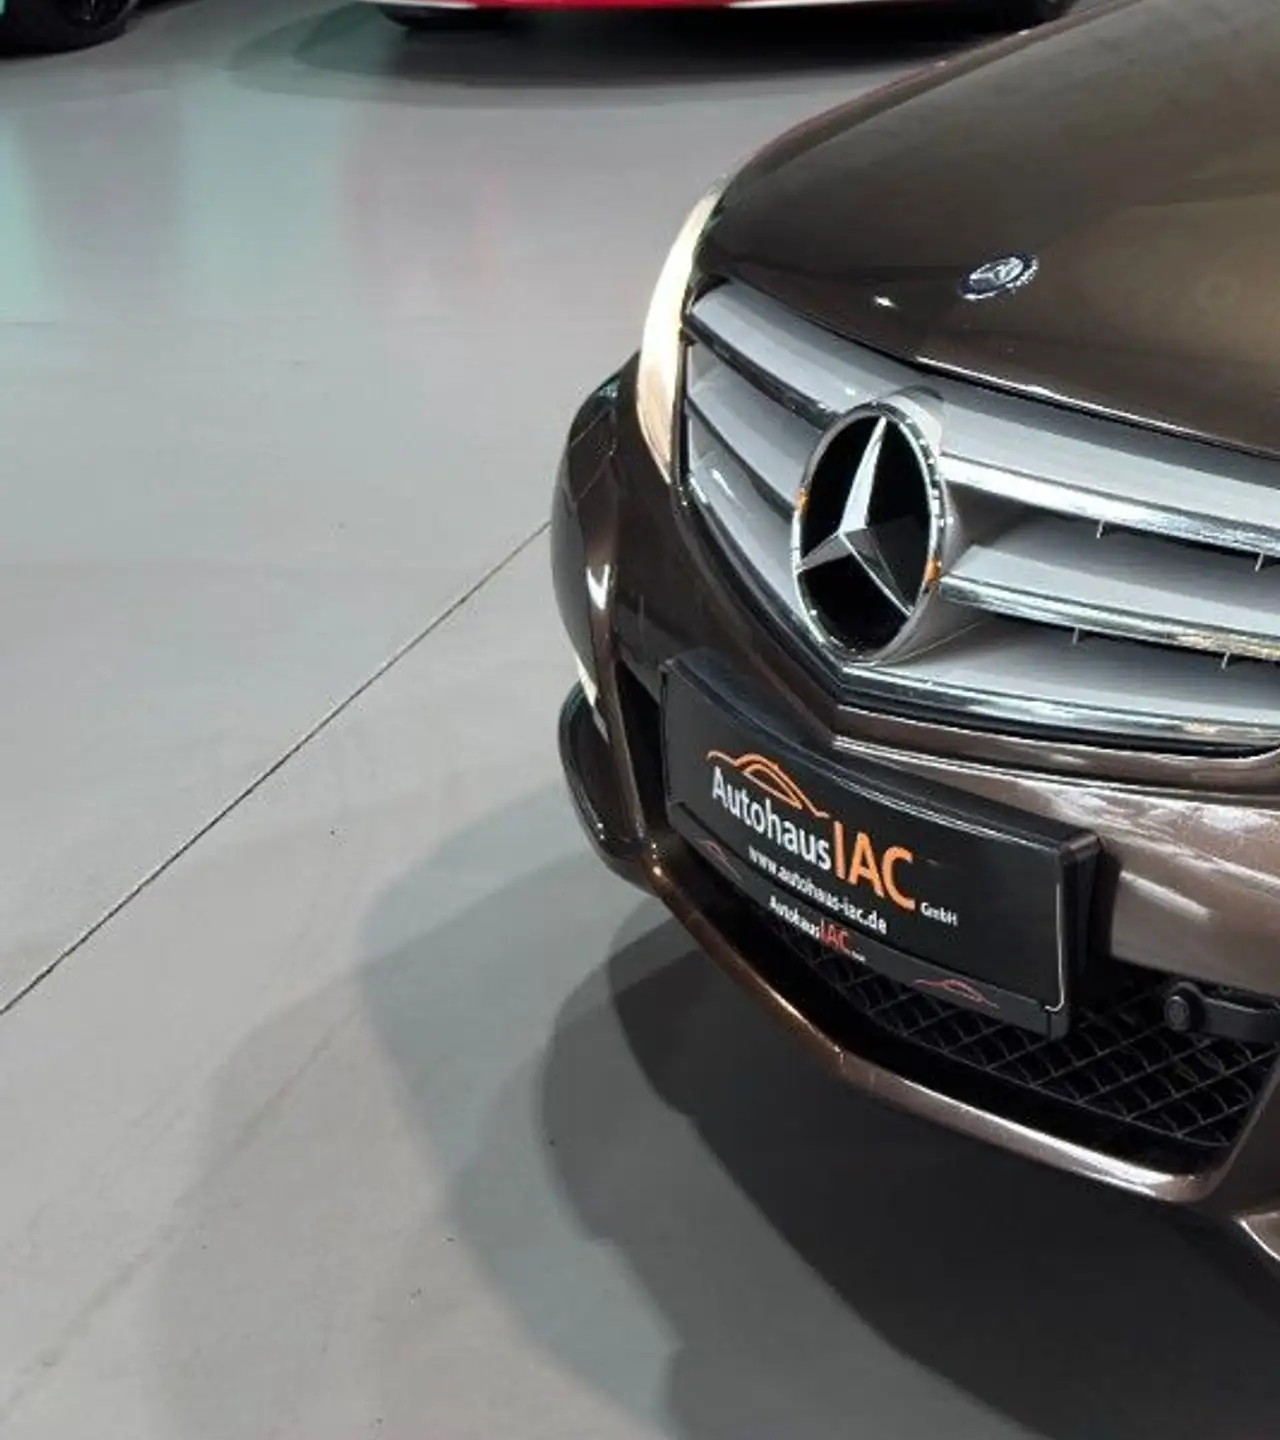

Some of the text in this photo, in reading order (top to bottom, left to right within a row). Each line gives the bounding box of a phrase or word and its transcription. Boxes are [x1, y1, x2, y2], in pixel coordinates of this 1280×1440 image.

[712, 765, 959, 927] Autohaus IAC GmbH
